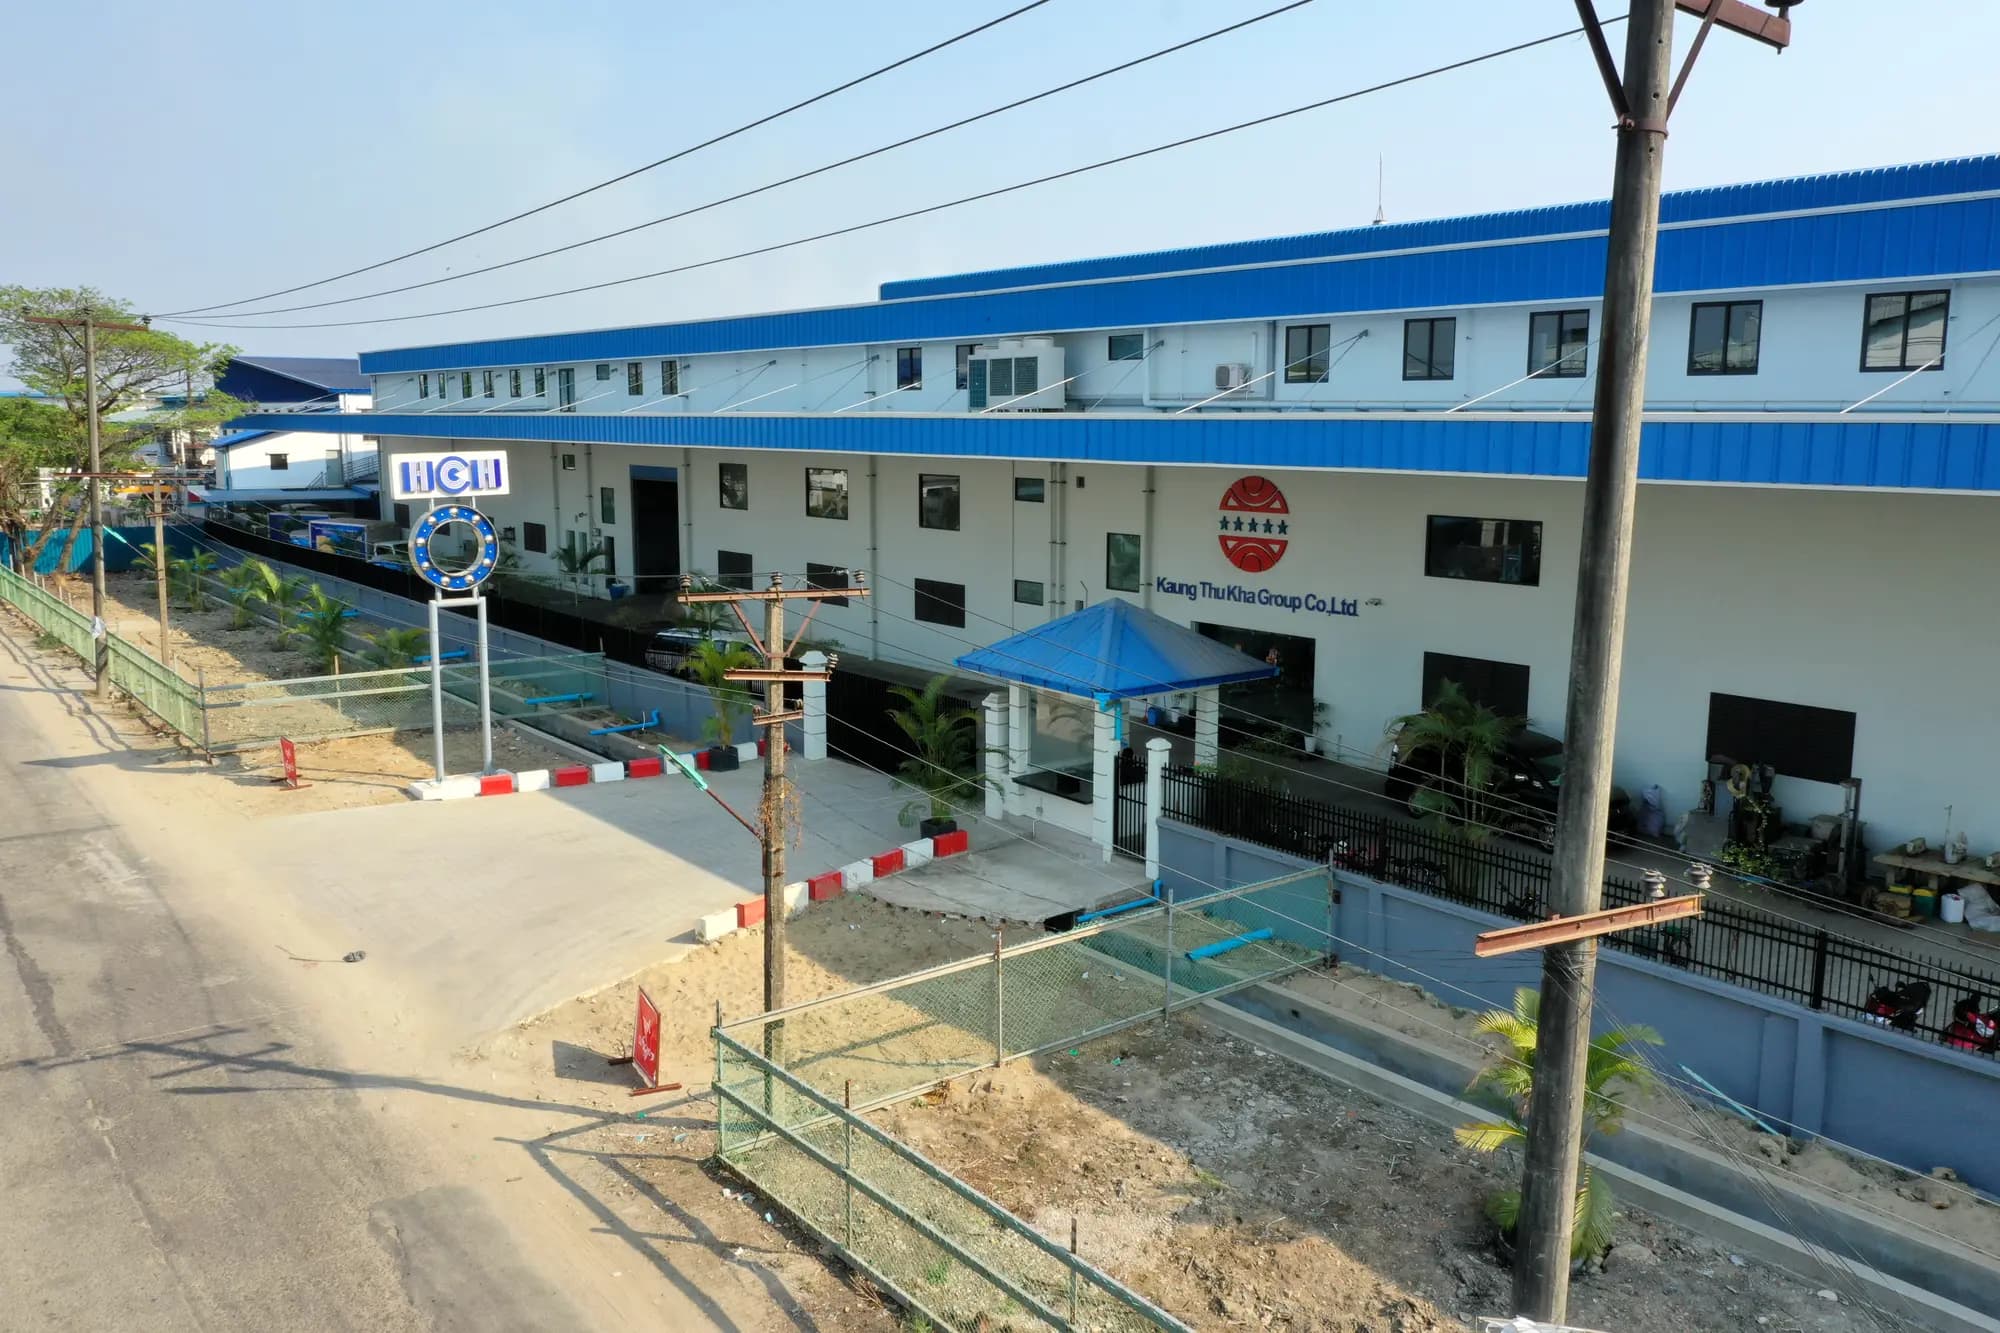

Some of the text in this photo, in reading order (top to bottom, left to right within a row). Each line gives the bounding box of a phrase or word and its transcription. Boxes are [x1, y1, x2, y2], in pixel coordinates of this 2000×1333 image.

[1157, 576, 1197, 601] Kaung
[1199, 581, 1226, 600] Thu
[1226, 584, 1256, 604] Kha
[1257, 588, 1302, 613] Group
